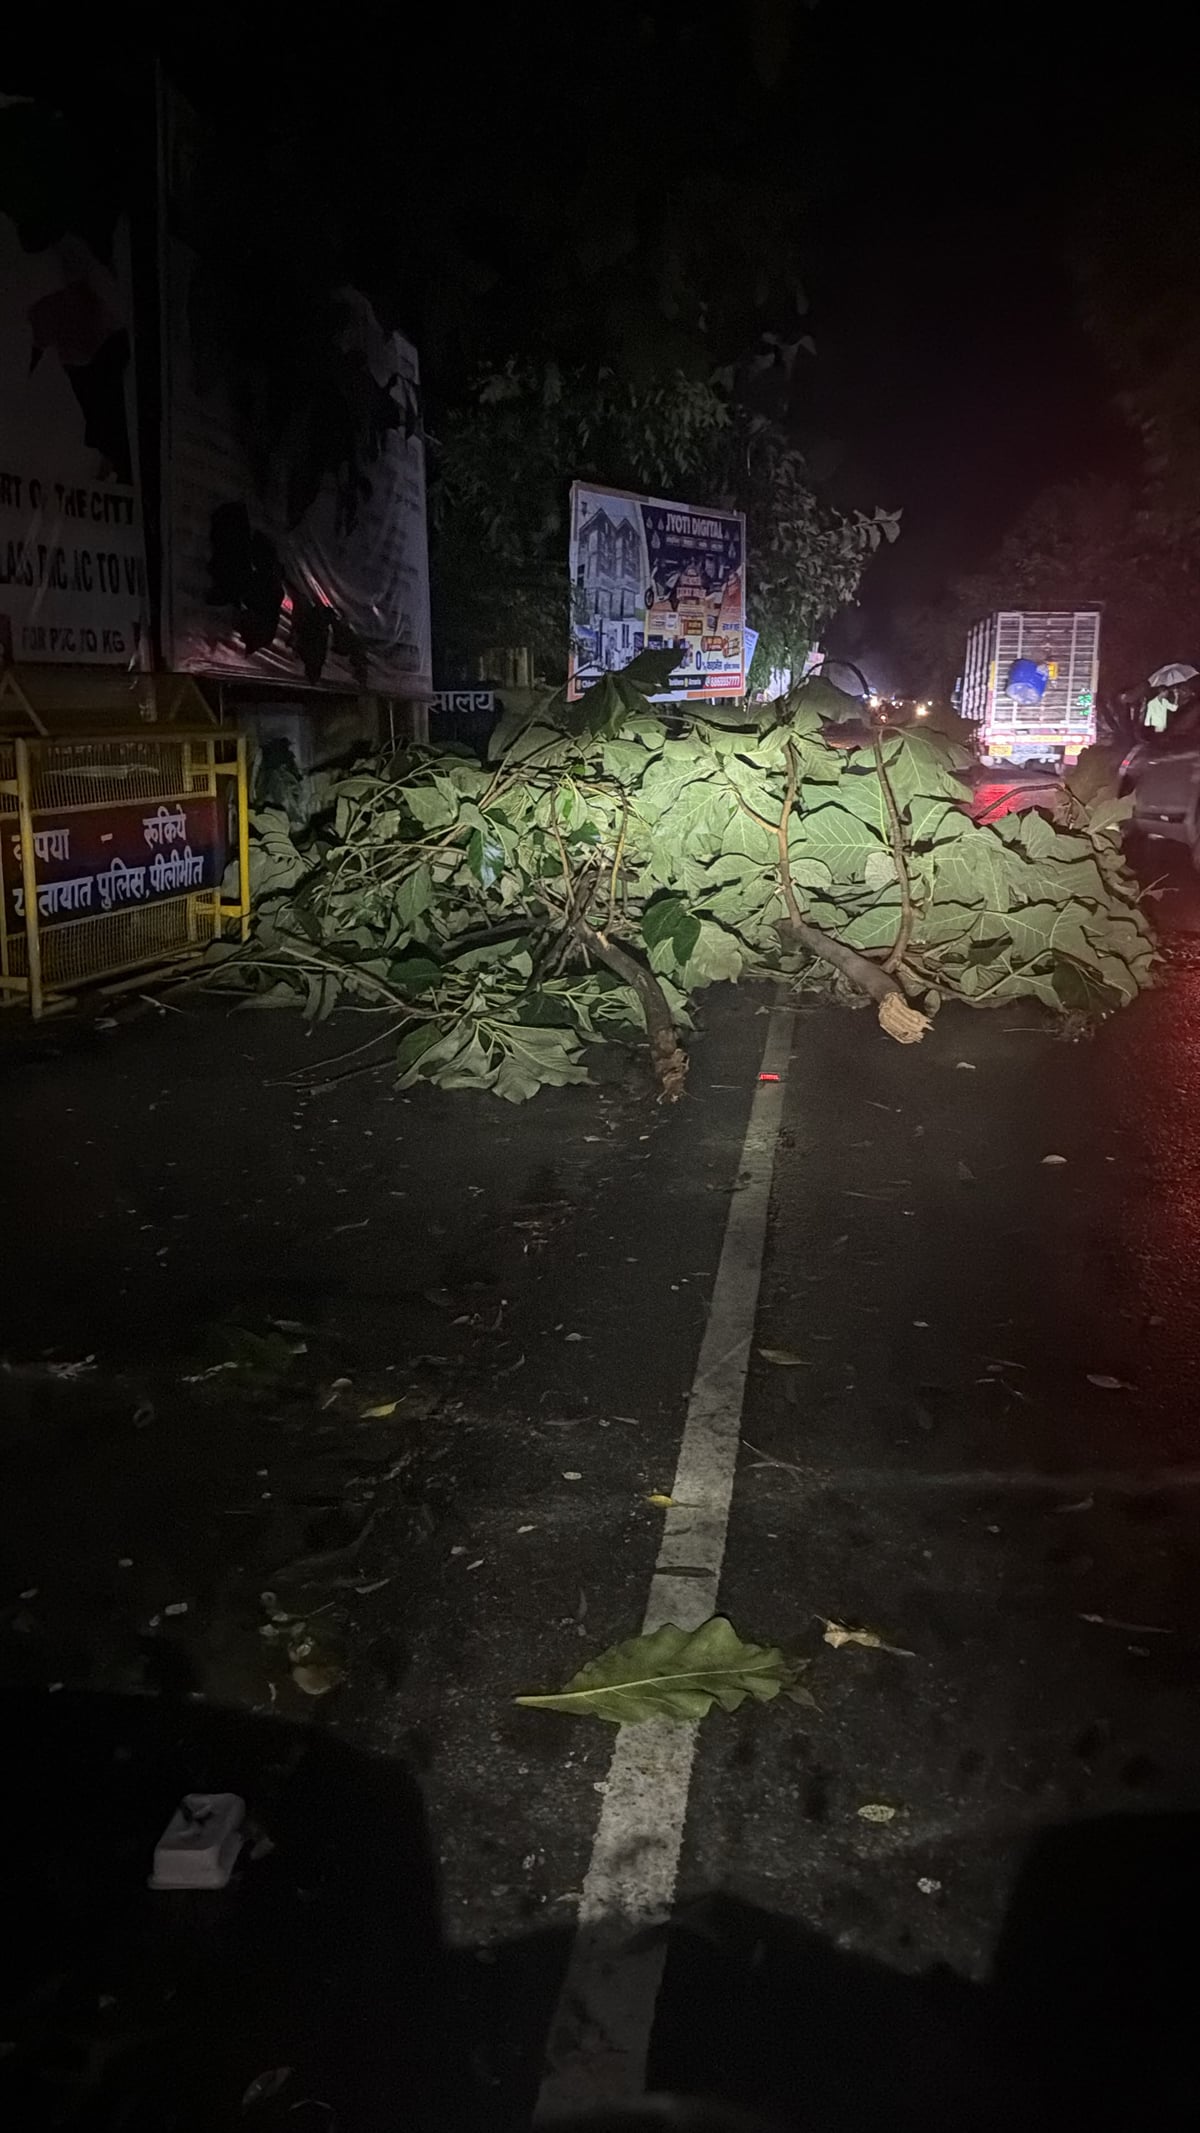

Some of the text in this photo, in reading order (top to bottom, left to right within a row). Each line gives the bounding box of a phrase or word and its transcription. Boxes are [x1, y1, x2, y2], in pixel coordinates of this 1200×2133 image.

[54, 482, 87, 518] THE
[91, 491, 134, 525] CITY
[666, 513, 723, 539] JYOTI DIGITAL
[102, 629, 125, 653] KG
[149, 845, 204, 892] पीलीभीत
